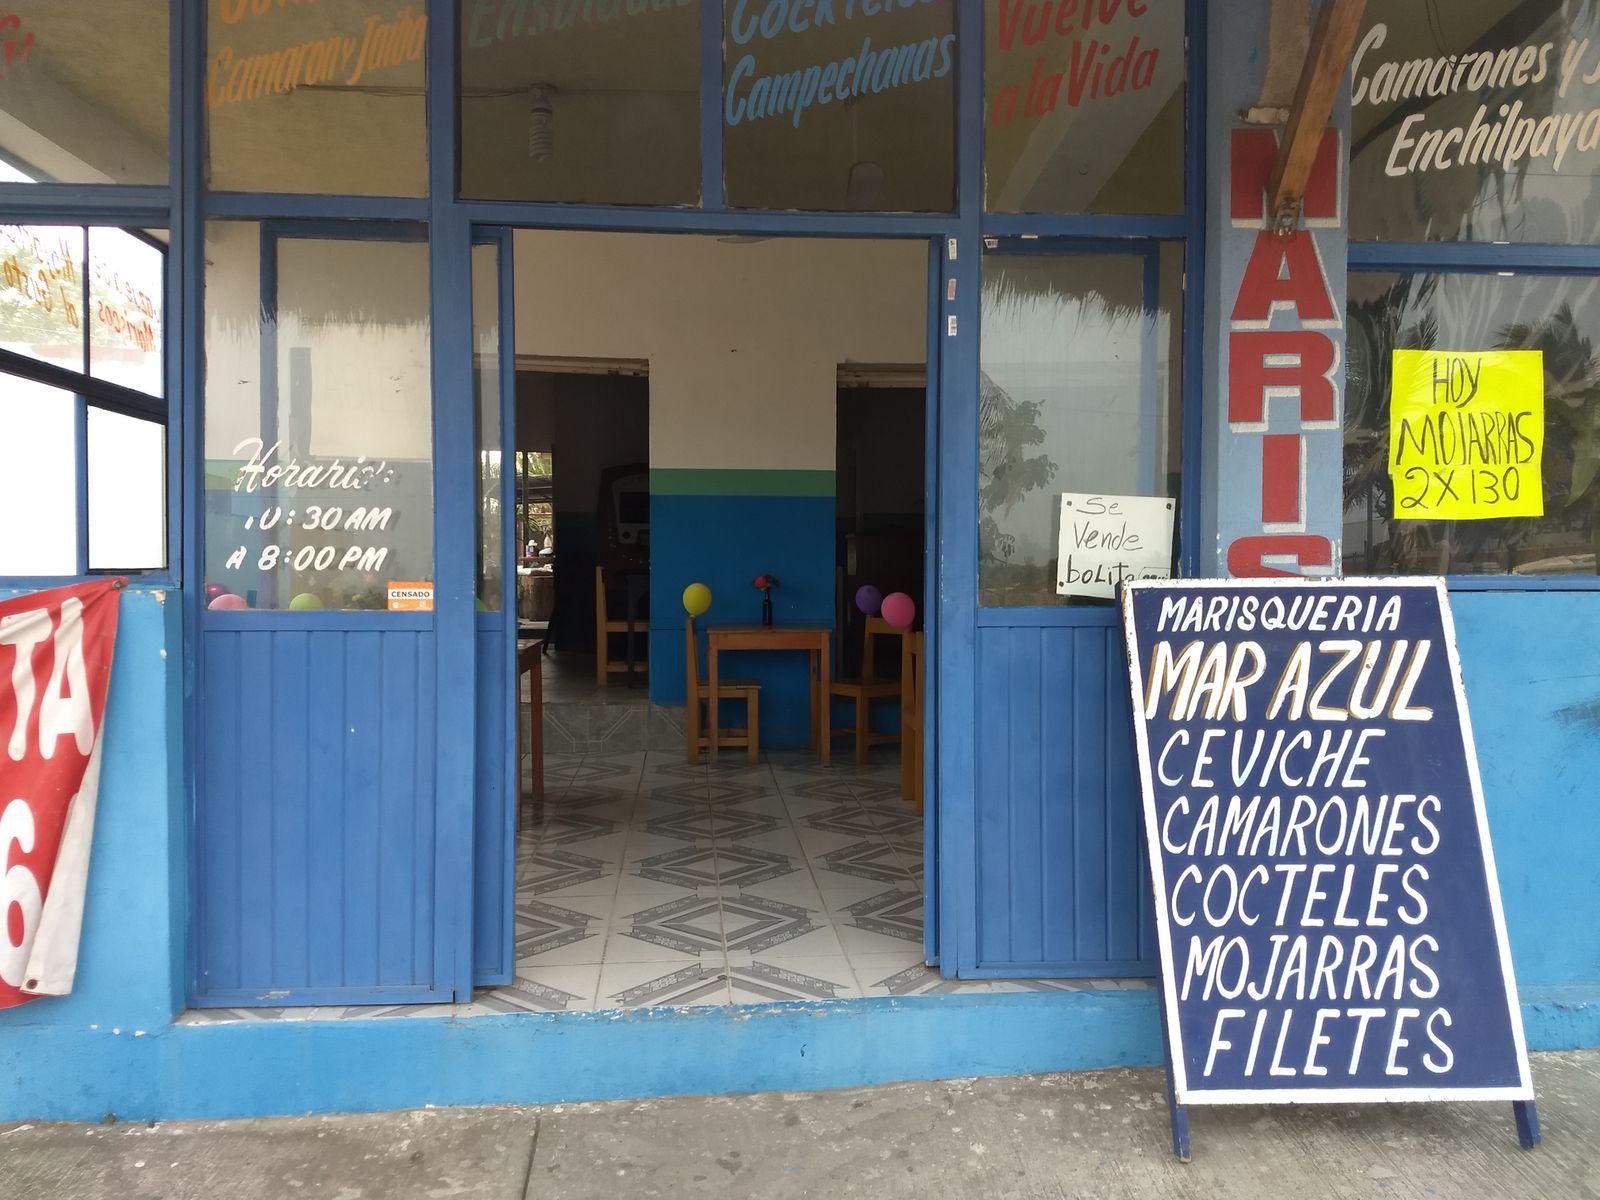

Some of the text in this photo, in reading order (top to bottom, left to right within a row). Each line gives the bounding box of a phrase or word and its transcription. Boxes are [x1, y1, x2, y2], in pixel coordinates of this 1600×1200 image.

[725, 34, 956, 129] Campechanas
[991, 36, 1160, 128] a la Vida
[1351, 22, 1590, 106] Camarones y
[1432, 357, 1482, 409] HOY
[1395, 411, 1535, 465] MOJARRAS
[344, 506, 392, 531] AM
[1073, 521, 1144, 551] Vende
[1076, 497, 1123, 515] Se
[225, 545, 389, 572] A 8:00 PM
[1157, 595, 1402, 633] MARISQUERIA
[1145, 640, 1434, 722] MAR AZUL
[1157, 729, 1387, 788] CEVICHE
[1162, 794, 1442, 857] CAMARONES
[1171, 864, 1431, 927] COCTELES
[1181, 934, 1440, 1001] MOJARRAS
[1203, 1007, 1455, 1077] FILETES
